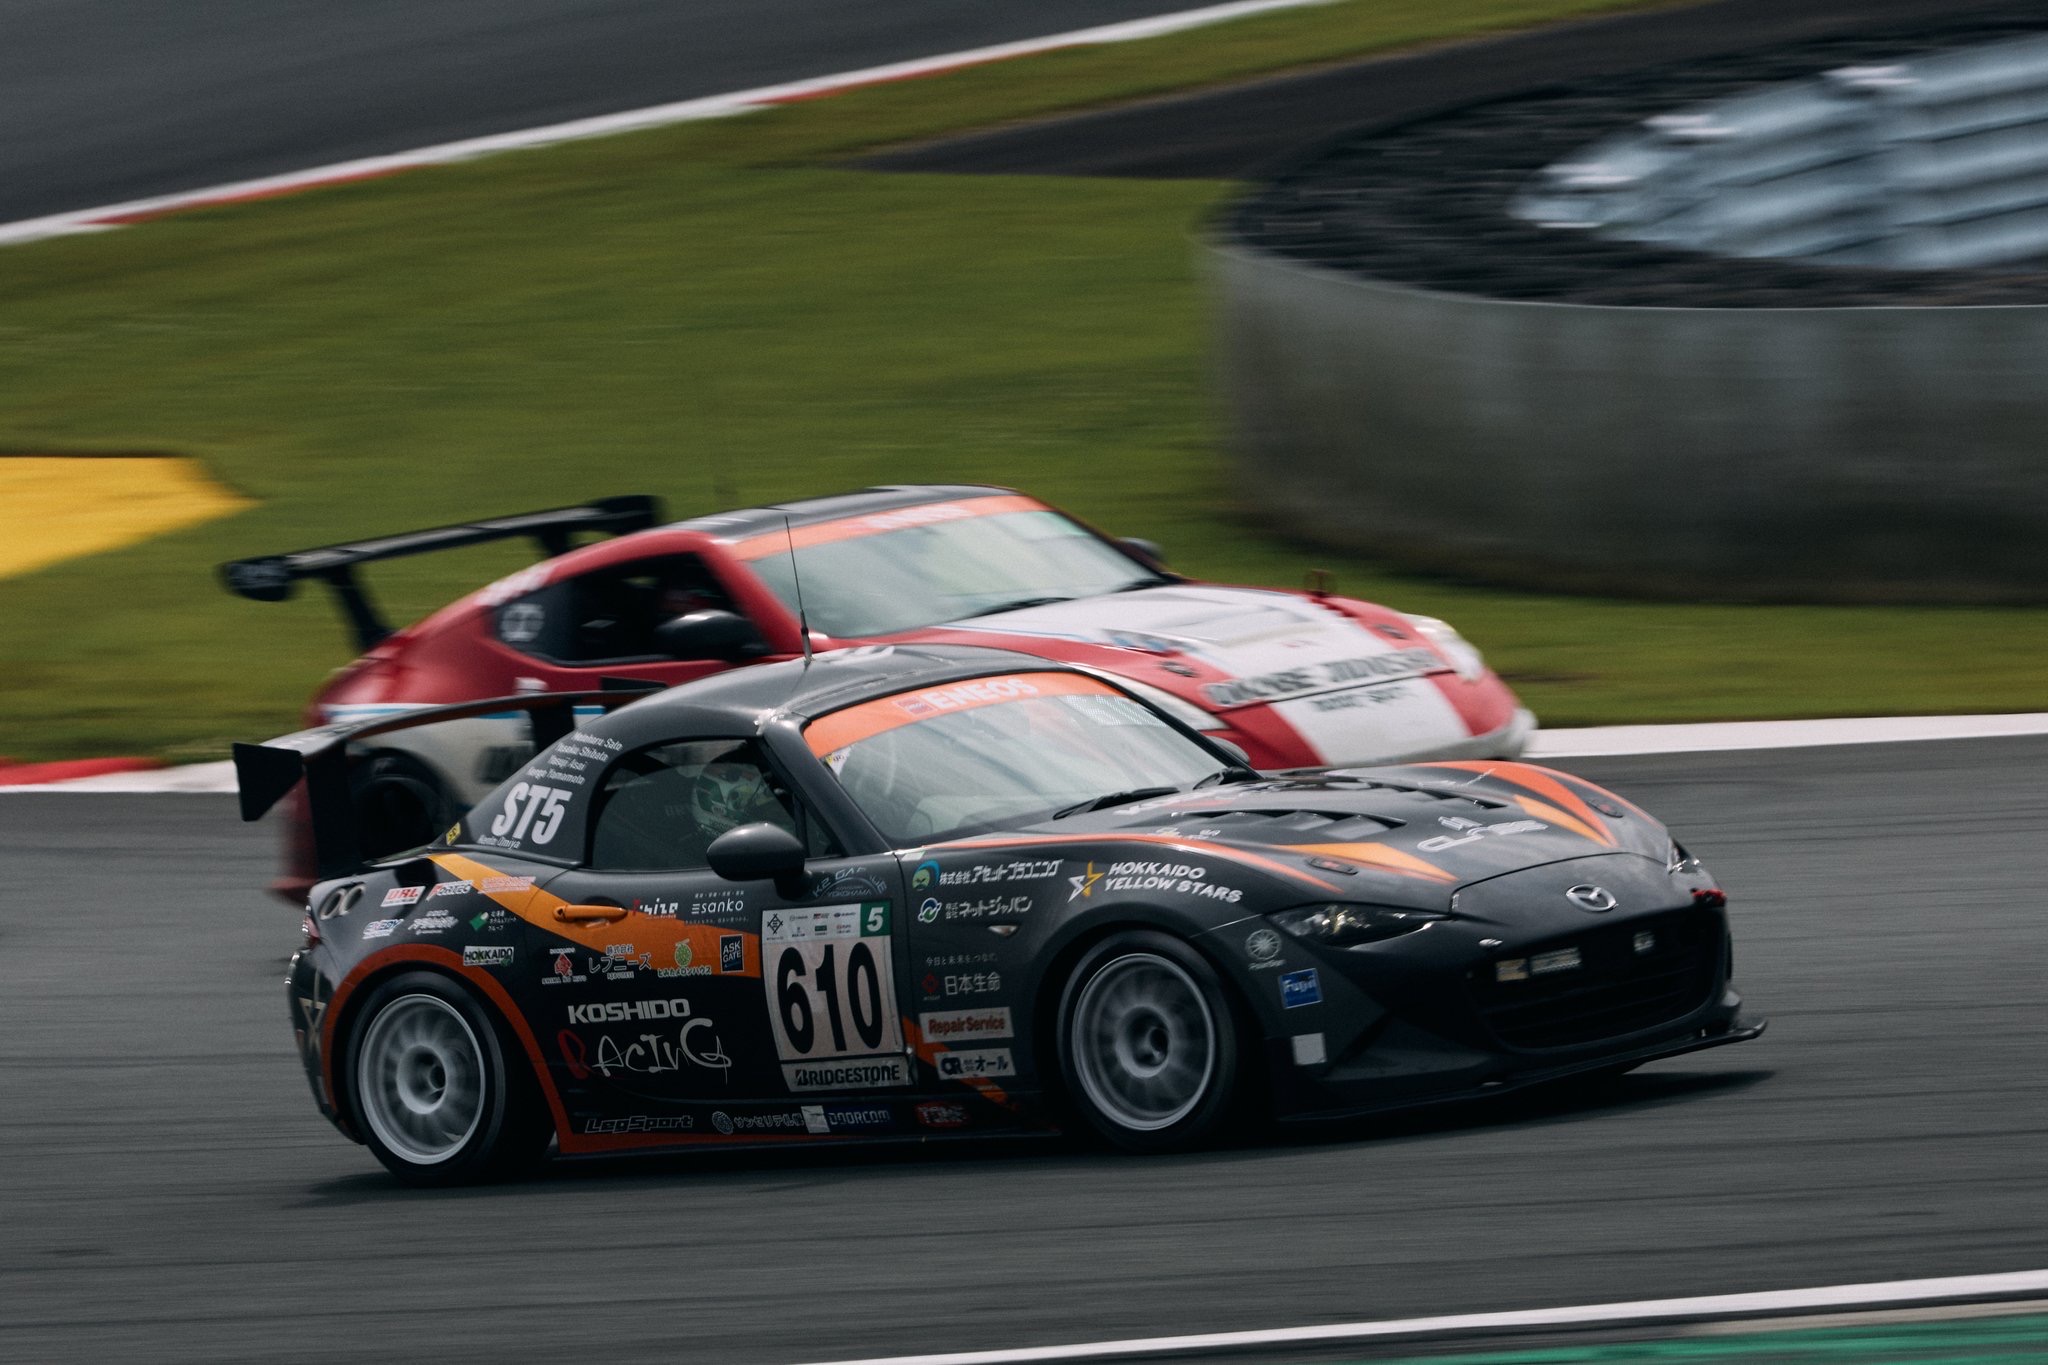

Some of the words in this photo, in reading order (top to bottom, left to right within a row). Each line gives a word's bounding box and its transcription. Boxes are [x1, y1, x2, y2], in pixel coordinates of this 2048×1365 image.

[921, 678, 1039, 709] ENEOS
[604, 738, 623, 751] Sato
[491, 782, 572, 845] ST5
[1107, 861, 1206, 879] HOKKAIDO
[1104, 877, 1177, 892] YELLOW
[1177, 879, 1243, 903] STARS
[866, 907, 884, 932] 5
[464, 948, 513, 961] HOKKAIDO
[722, 940, 741, 955] ASK
[722, 950, 742, 963] GATE
[944, 971, 1001, 996] 日本生命
[777, 942, 883, 1054] 610
[567, 998, 691, 1025] KOSHIDO
[795, 1064, 900, 1086] BRIDGESTONE
